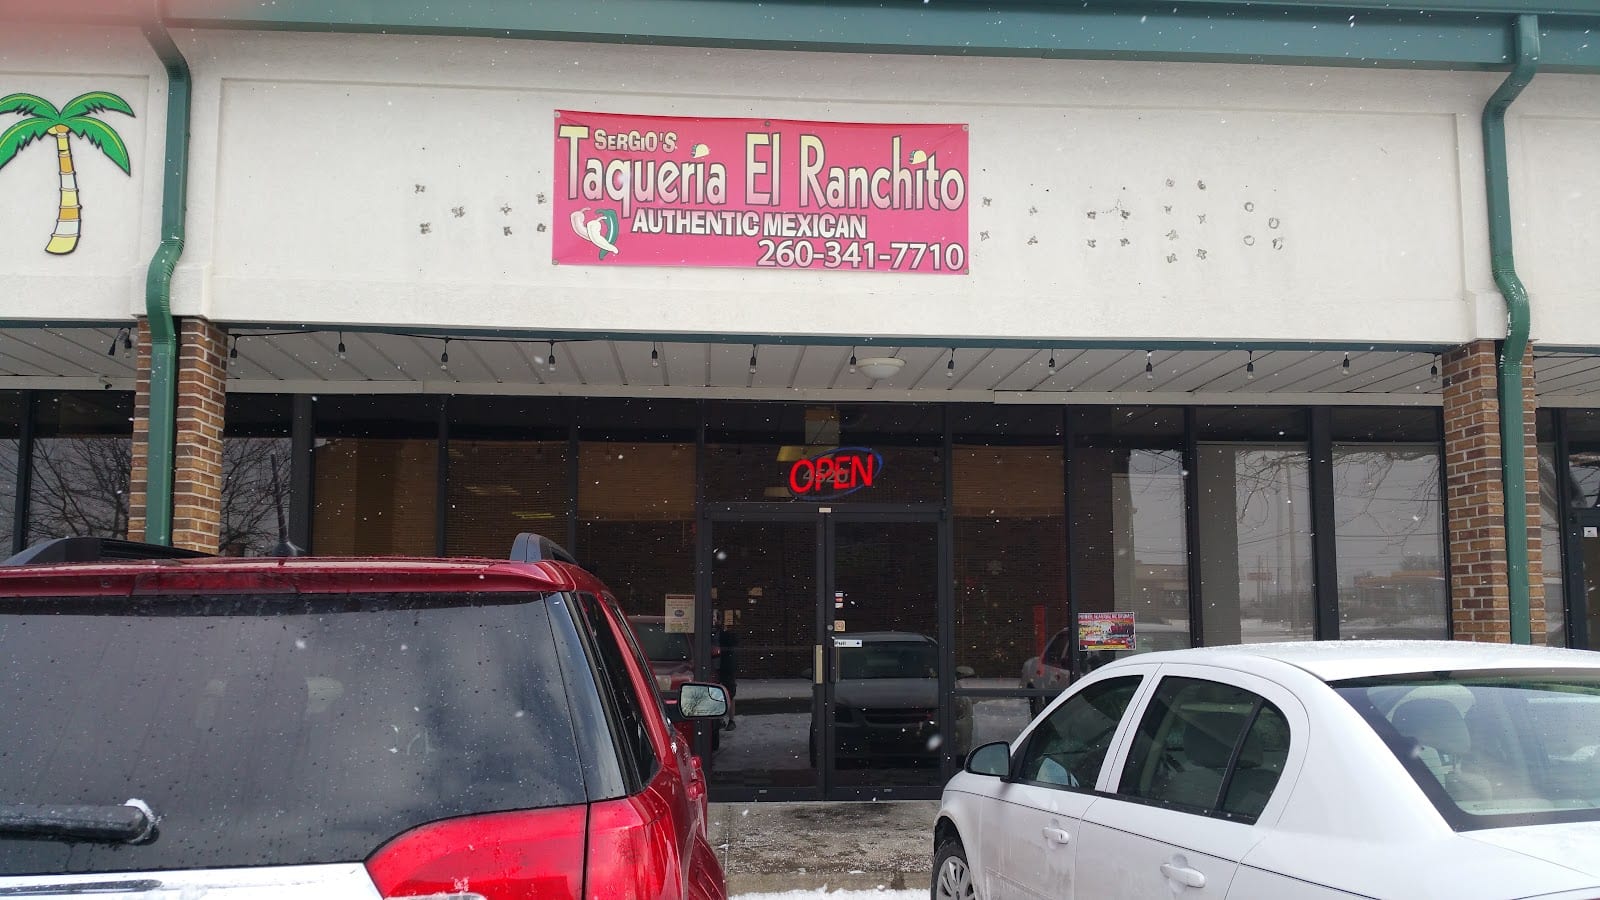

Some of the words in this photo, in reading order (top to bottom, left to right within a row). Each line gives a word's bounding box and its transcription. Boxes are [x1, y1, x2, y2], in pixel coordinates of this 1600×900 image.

[558, 125, 727, 219] Taqueria
[745, 132, 781, 206] El
[799, 134, 965, 211] Ranchito
[631, 207, 760, 236] AUTHENTIC
[763, 212, 867, 239] MEXICAN
[757, 239, 965, 270] 260-341-7710
[789, 453, 874, 494] OPEN
[803, 468, 848, 483] 4520
